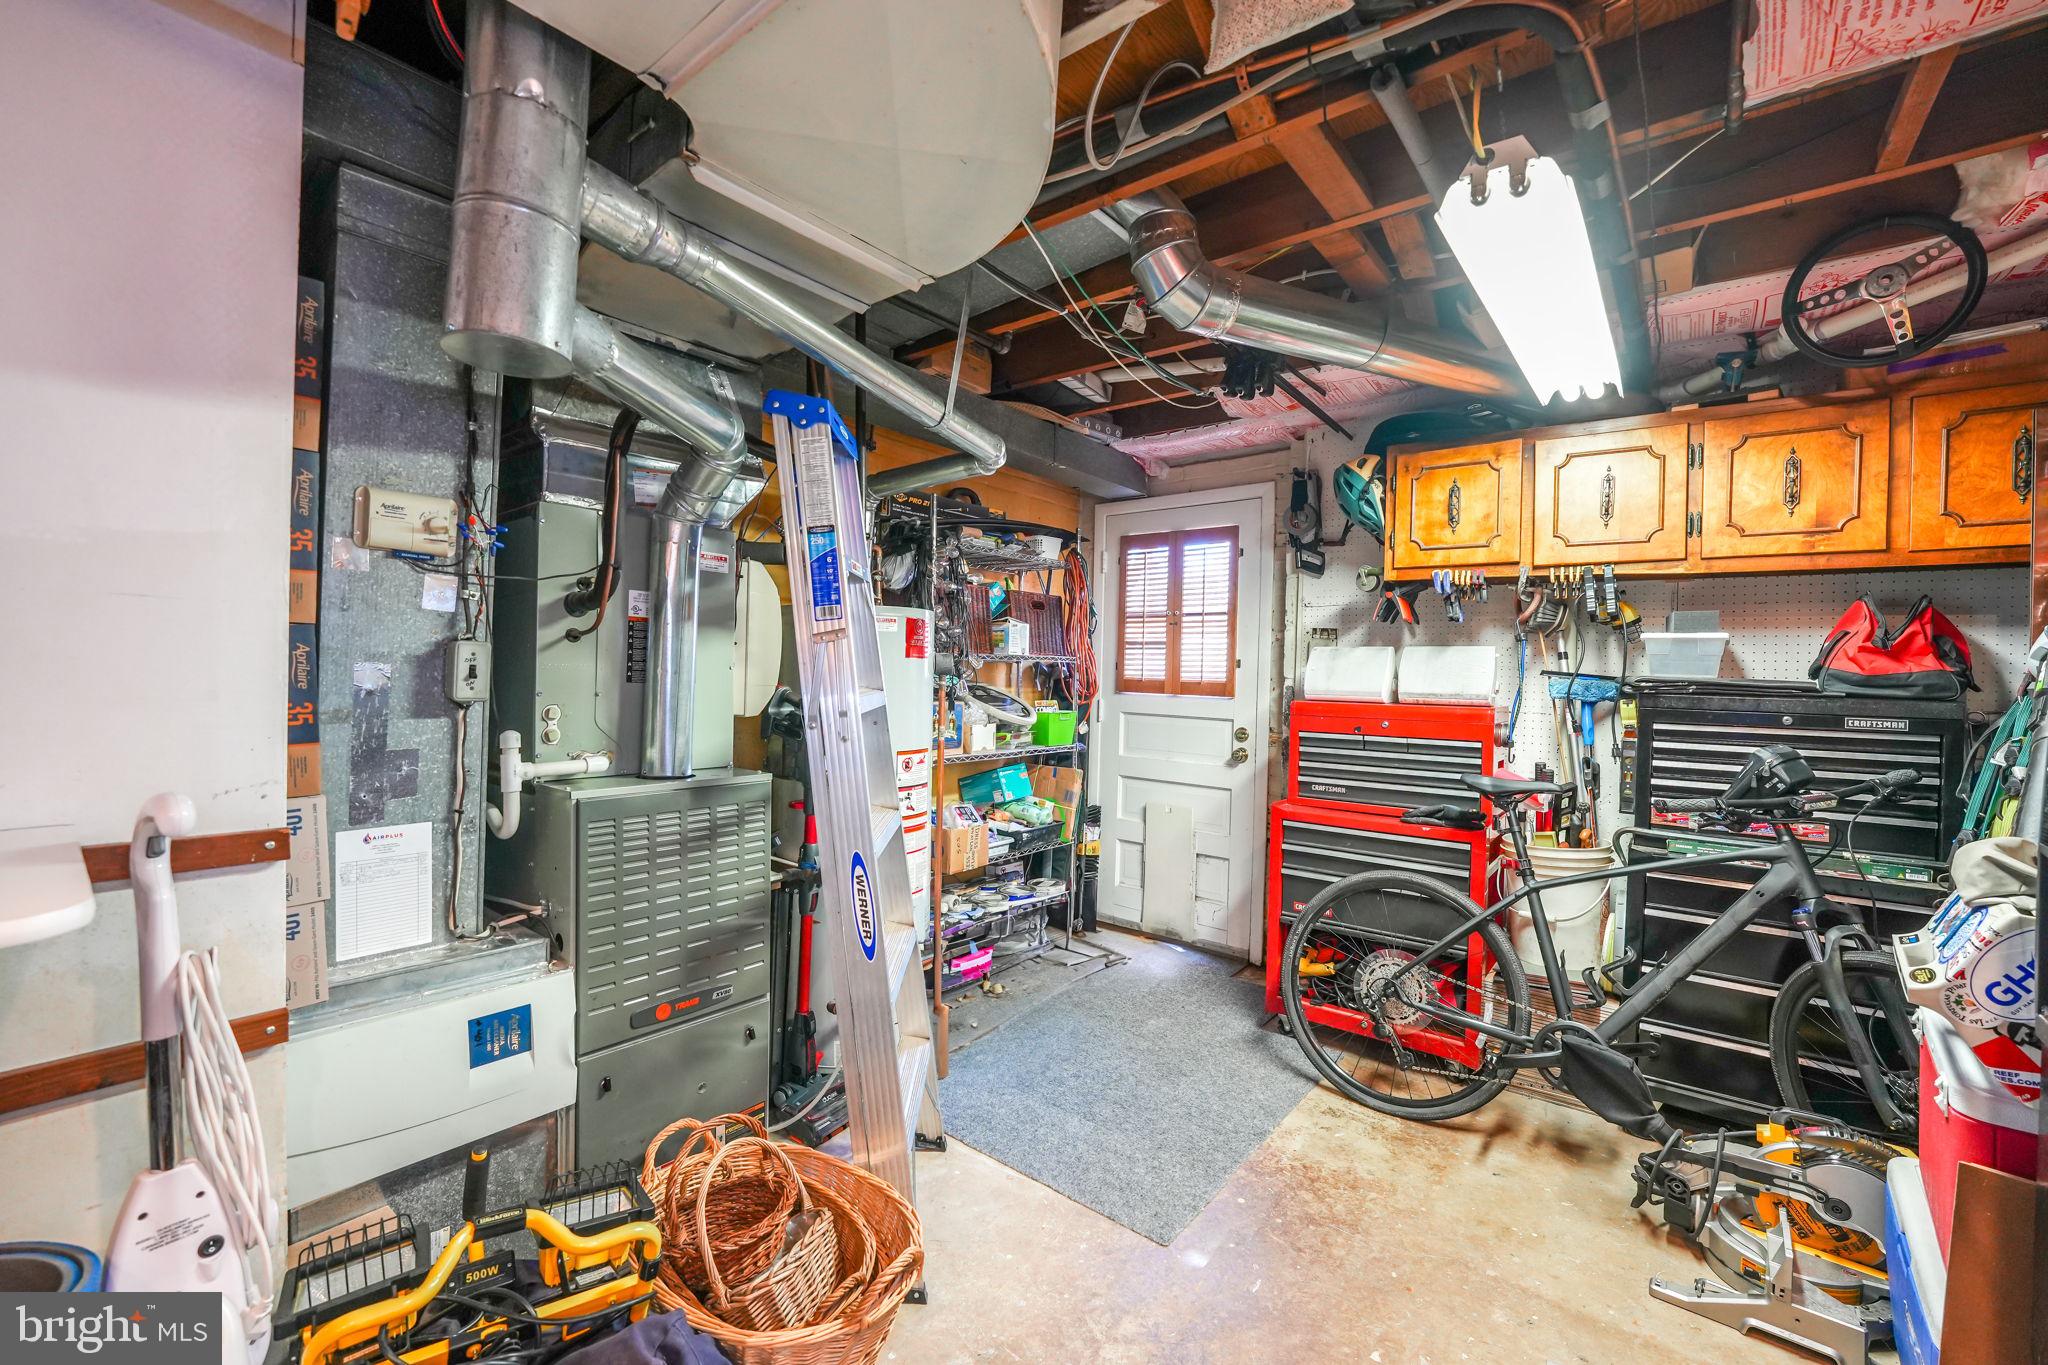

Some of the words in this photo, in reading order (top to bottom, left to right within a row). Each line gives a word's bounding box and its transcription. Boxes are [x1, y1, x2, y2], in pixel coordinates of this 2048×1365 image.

[303, 296, 318, 343] Aprilaire
[297, 468, 314, 517] Aprilaire
[908, 497, 922, 505] PRO
[380, 502, 406, 511] Aprilaire
[290, 528, 314, 552] 35
[294, 643, 310, 690] Aprilaire
[288, 702, 314, 726] 35
[1848, 720, 1905, 729] CRAFTSMAN
[1311, 784, 1346, 794] CRAFTSMAN
[372, 832, 404, 841] AIRPLUS
[855, 874, 872, 940] WERNER
[285, 913, 301, 941] 401
[715, 988, 732, 998] XV80
[2011, 1003, 2022, 1016] GUY
[511, 1014, 521, 1050] Aprilaire
[1993, 1069, 2020, 1079] REEF
[465, 1264, 499, 1283] 500W
